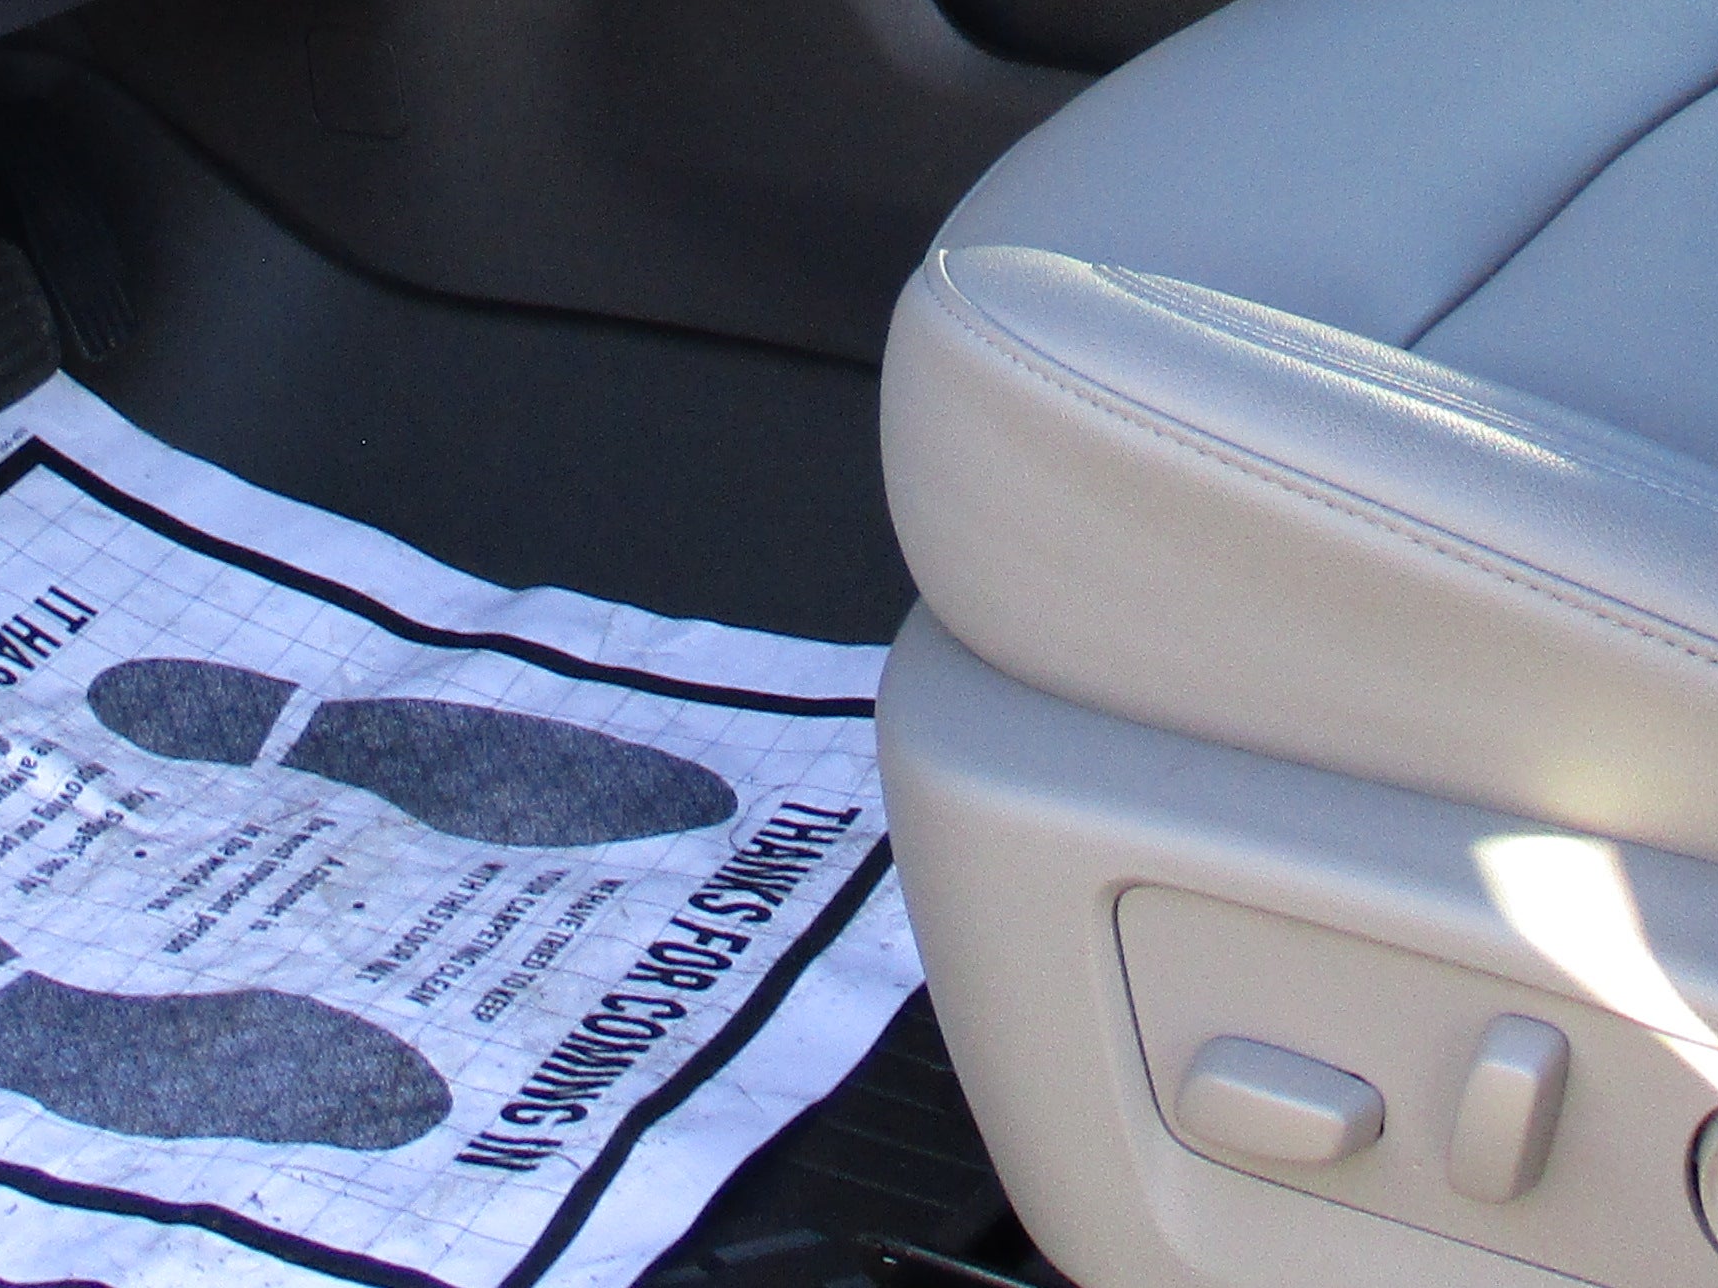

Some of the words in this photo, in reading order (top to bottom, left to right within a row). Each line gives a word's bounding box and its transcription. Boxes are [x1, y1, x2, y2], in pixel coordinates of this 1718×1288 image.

[34, 585, 99, 635] IT
[688, 801, 863, 924] THANKS
[426, 889, 477, 921] THIS
[555, 891, 610, 931] HAVE
[383, 916, 444, 962] FLOOR
[449, 895, 537, 967] CARPETING
[521, 930, 575, 970] TRIED
[625, 915, 753, 992] FOR
[403, 963, 465, 1008] CLEAN
[500, 971, 538, 990] TO
[471, 986, 519, 1024] KEEP
[499, 993, 688, 1126] COMING
[453, 1131, 564, 1172] IN
